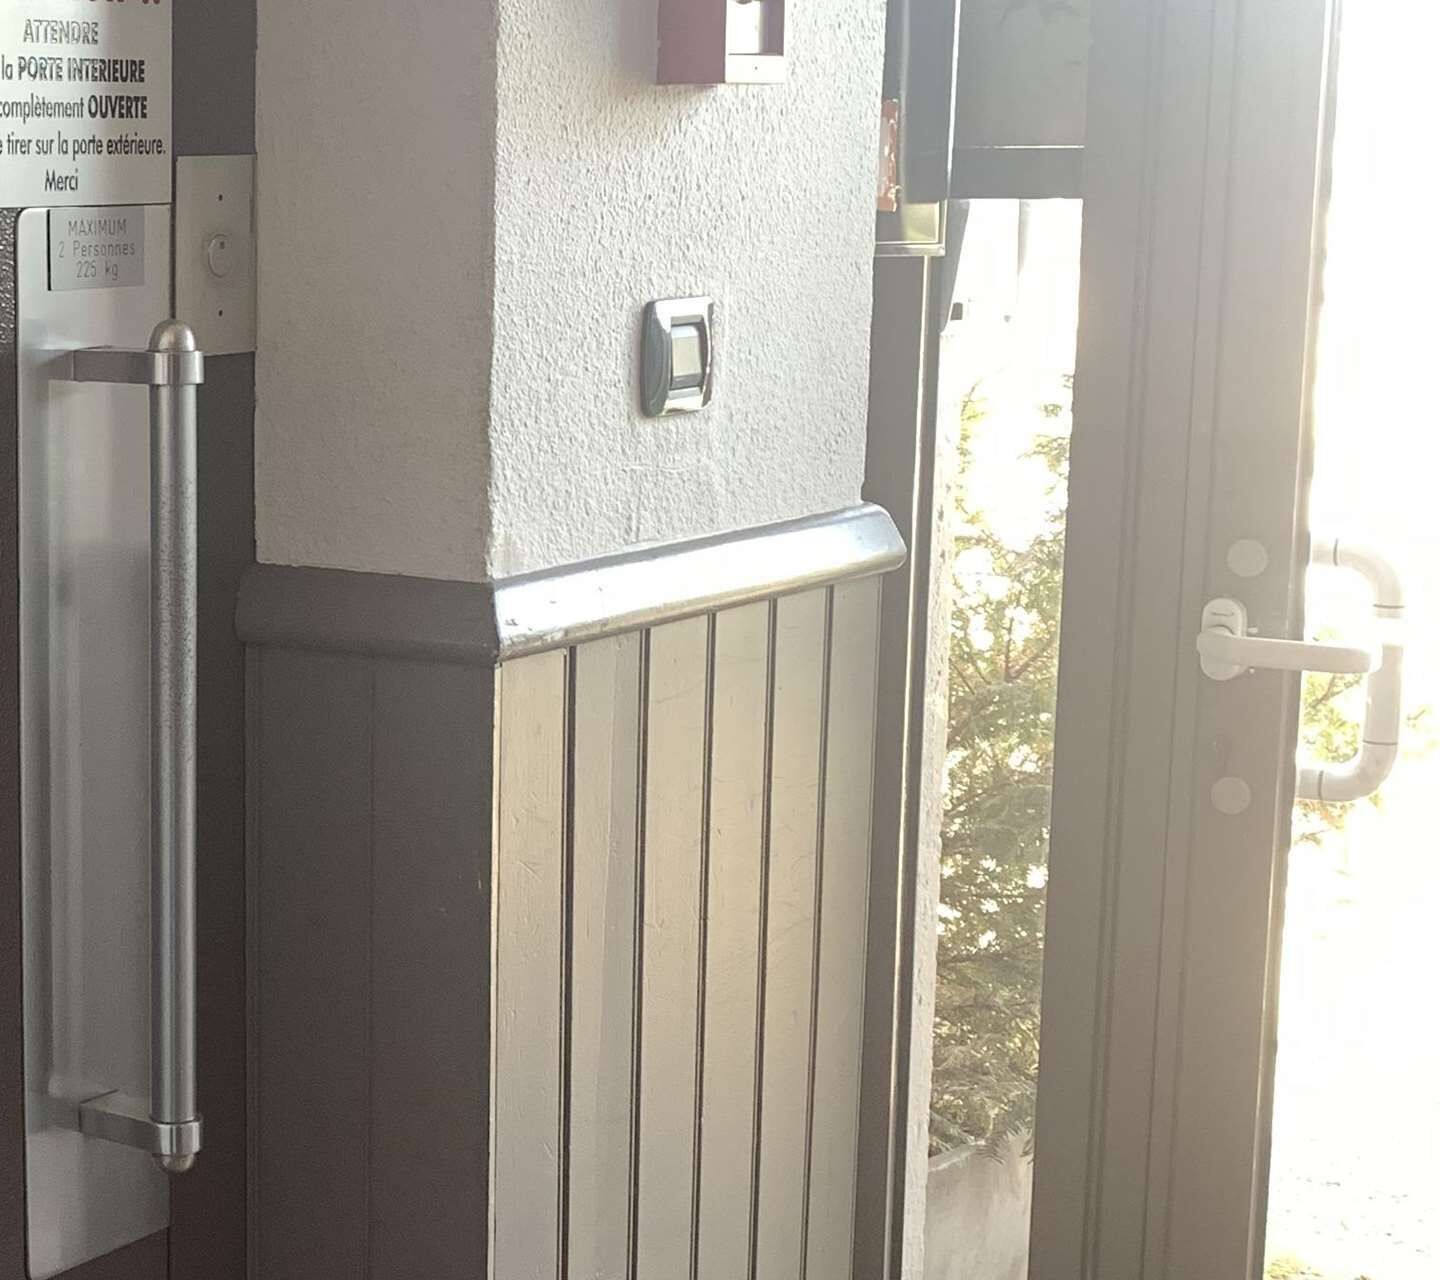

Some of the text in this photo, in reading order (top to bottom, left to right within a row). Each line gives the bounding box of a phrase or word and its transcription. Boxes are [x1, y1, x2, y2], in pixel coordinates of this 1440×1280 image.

[23, 18, 99, 46] ATTENDRE
[1, 54, 13, 81] la
[17, 55, 63, 82] PORTE
[67, 57, 145, 83] INTERIEURE
[87, 94, 148, 119] OUVERTE
[7, 131, 33, 156] tirer
[35, 138, 55, 156] sur
[57, 130, 68, 155] la
[72, 133, 103, 161] porte
[106, 130, 166, 156] extérieure.
[44, 167, 79, 192] Merci
[67, 218, 128, 237] MAXIMUM
[72, 240, 137, 258] Personnes
